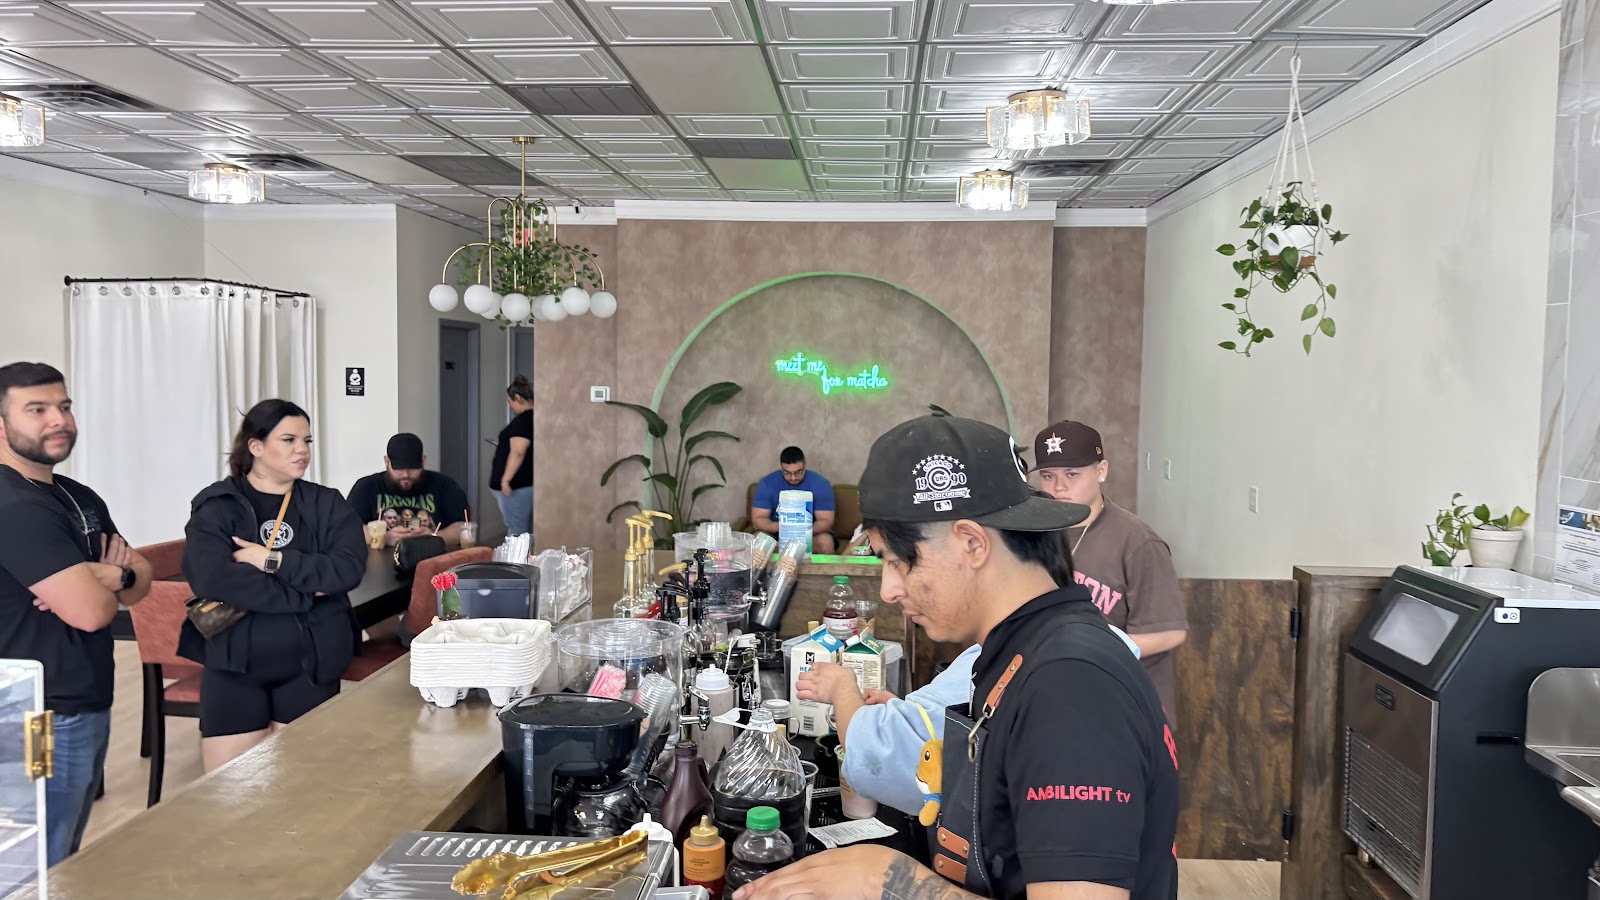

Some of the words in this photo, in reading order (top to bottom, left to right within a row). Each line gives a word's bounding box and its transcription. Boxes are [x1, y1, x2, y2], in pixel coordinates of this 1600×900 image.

[775, 352, 806, 376] meet
[807, 360, 826, 372] me
[847, 365, 888, 389] matcha
[923, 460, 953, 471] CHICAGO
[376, 493, 436, 514] LEGOLAS
[1026, 785, 1112, 802] AMBILIGHT
[1116, 789, 1131, 803] tv
